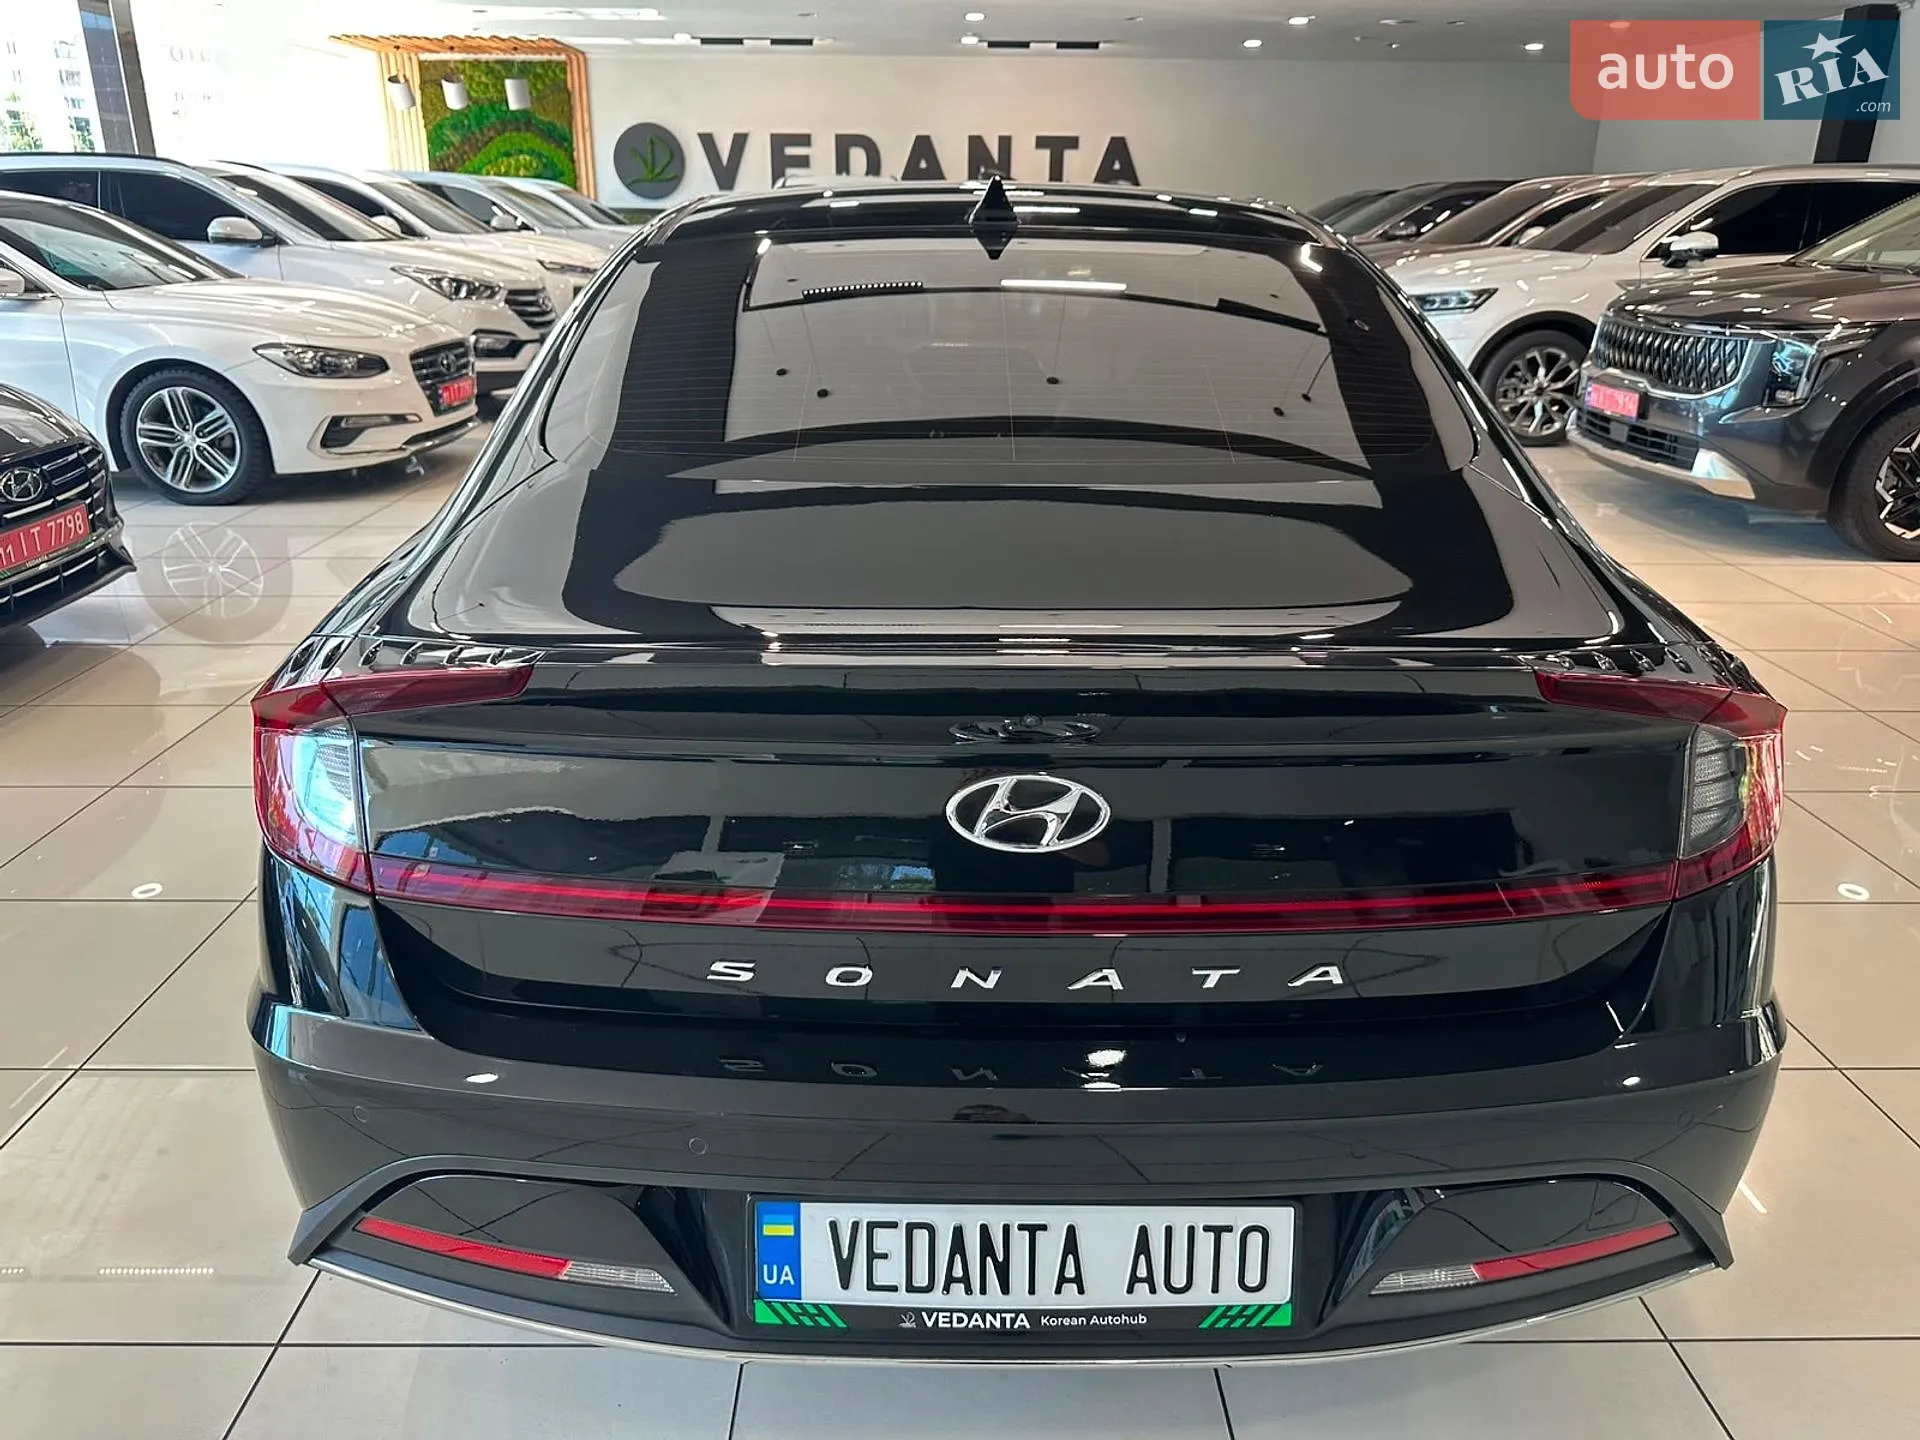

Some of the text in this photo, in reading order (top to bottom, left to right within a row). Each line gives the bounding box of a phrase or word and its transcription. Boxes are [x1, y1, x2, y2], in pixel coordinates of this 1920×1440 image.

[47, 512, 84, 546] 7798
[707, 960, 1344, 991] SONATA
[827, 1219, 1270, 1296] VEDANTA AUTO
[763, 1266, 794, 1285] UA
[921, 1311, 1147, 1329] VEDANTA Korean Autohub
